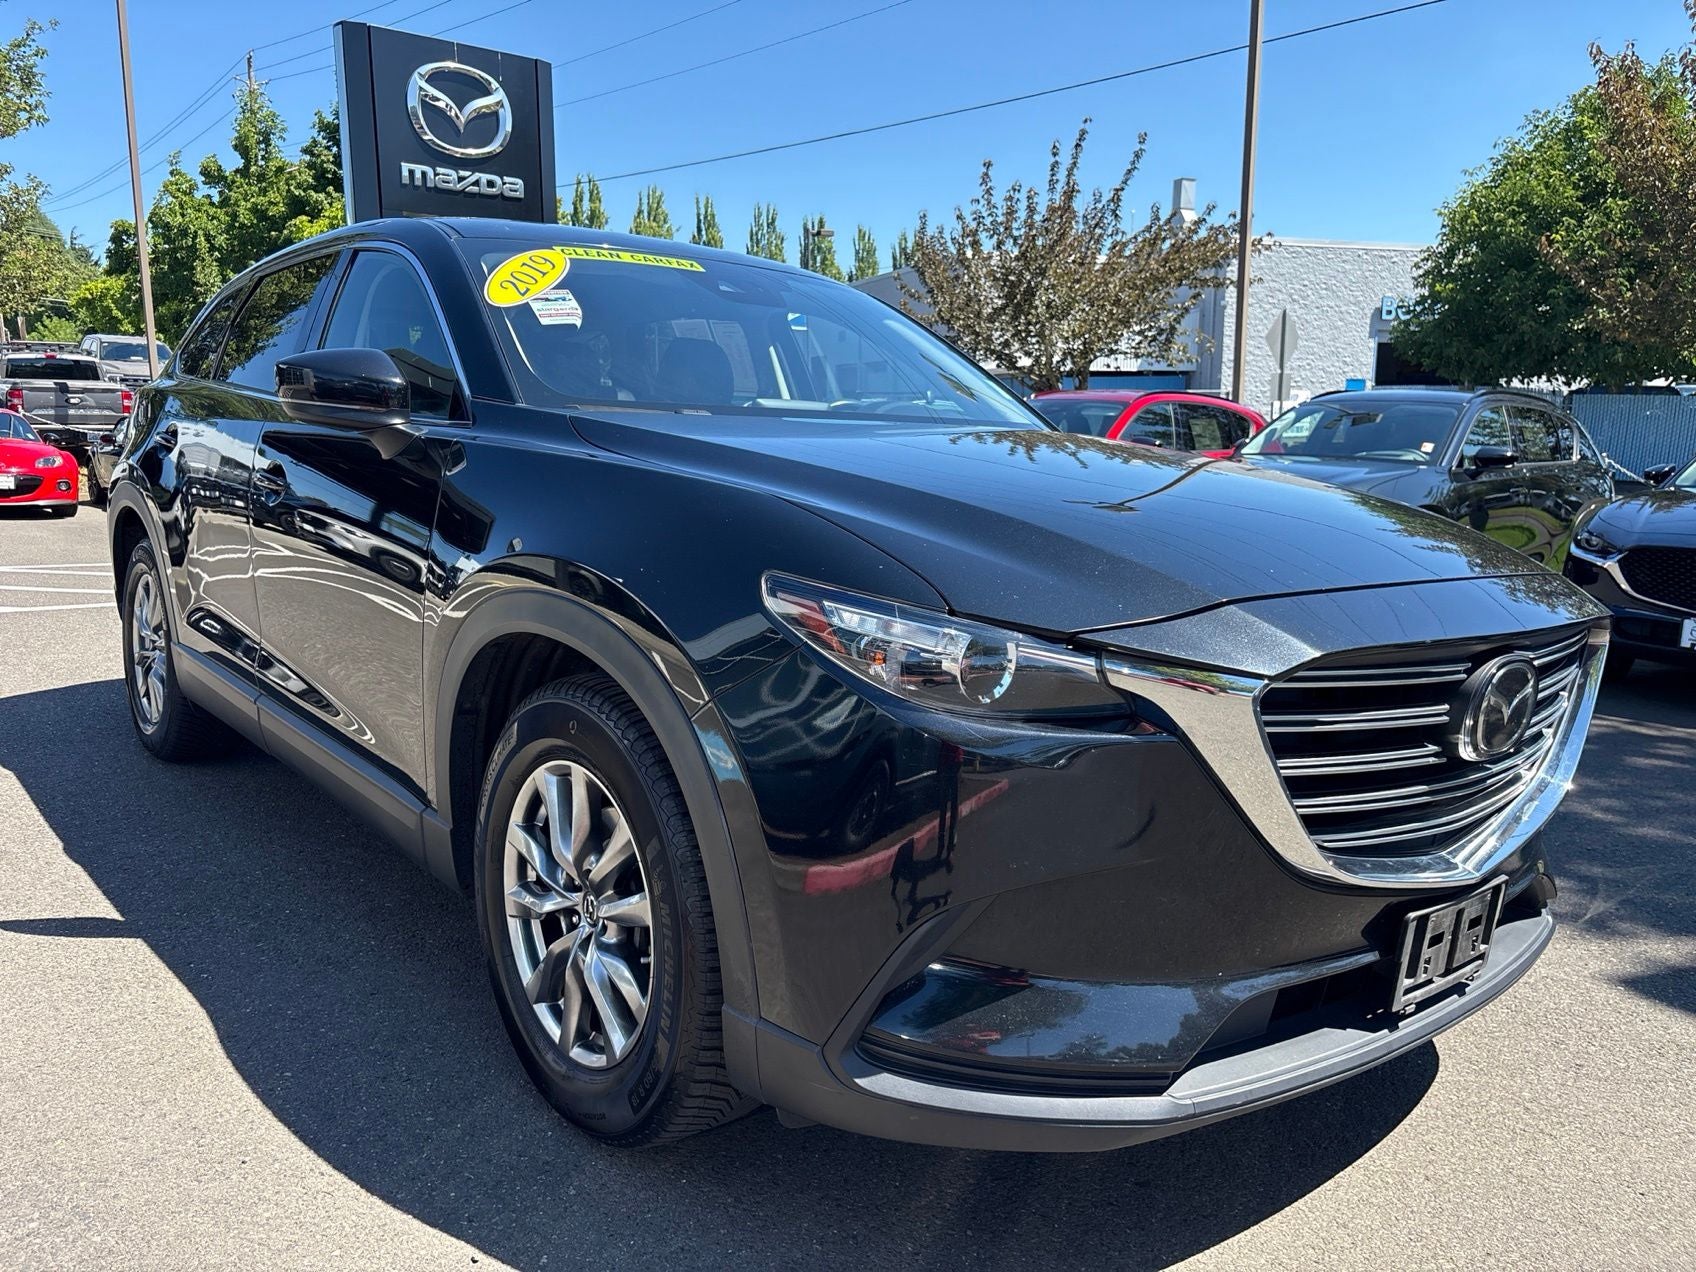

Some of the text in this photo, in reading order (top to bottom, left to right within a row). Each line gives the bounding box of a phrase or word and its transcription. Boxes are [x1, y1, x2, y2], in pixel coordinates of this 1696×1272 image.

[499, 254, 556, 297] 2019
[560, 248, 700, 270] CLEAN CARFAX
[659, 901, 675, 1038] MICHELIN
